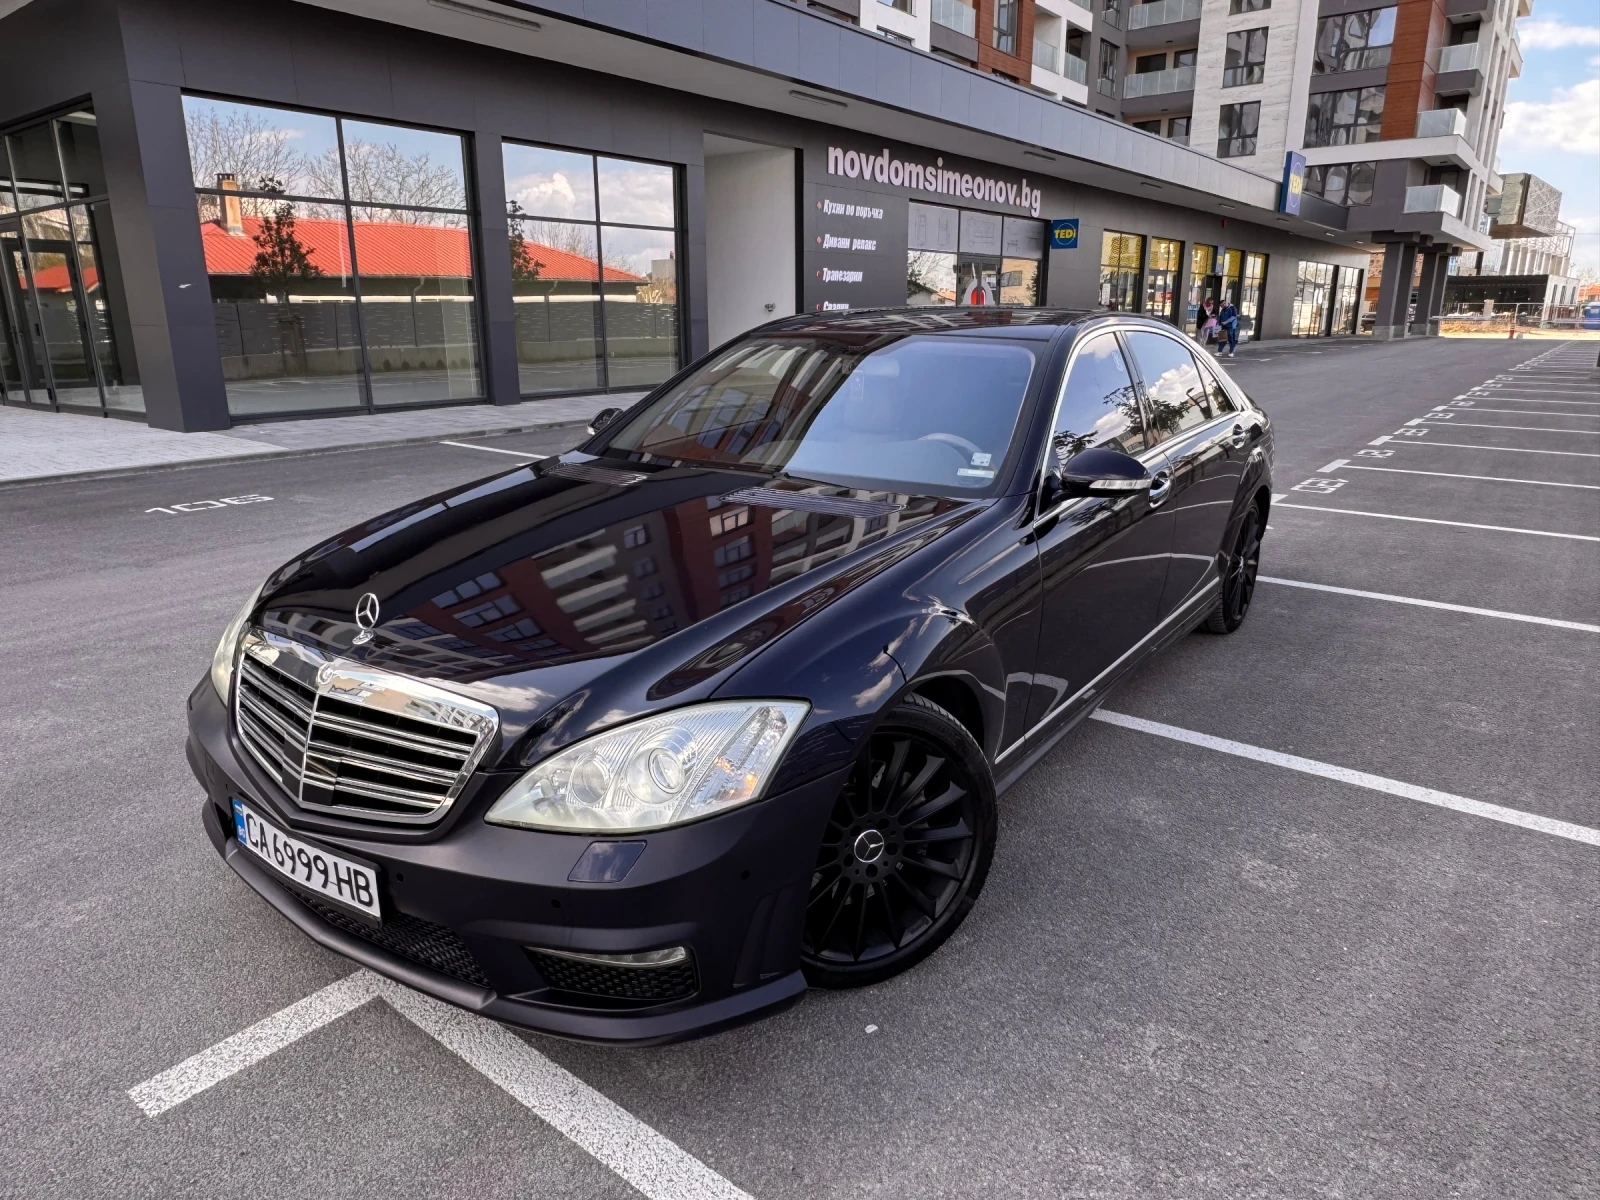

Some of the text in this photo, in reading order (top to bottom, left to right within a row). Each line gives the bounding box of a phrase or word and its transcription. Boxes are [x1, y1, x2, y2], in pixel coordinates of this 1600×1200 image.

[828, 146, 1041, 218] novdomsimeonov.bg
[823, 199, 884, 219] Кухни по поръчка
[823, 233, 851, 249] Дивани
[822, 267, 863, 284] Трапезарии
[144, 494, 275, 515] 106
